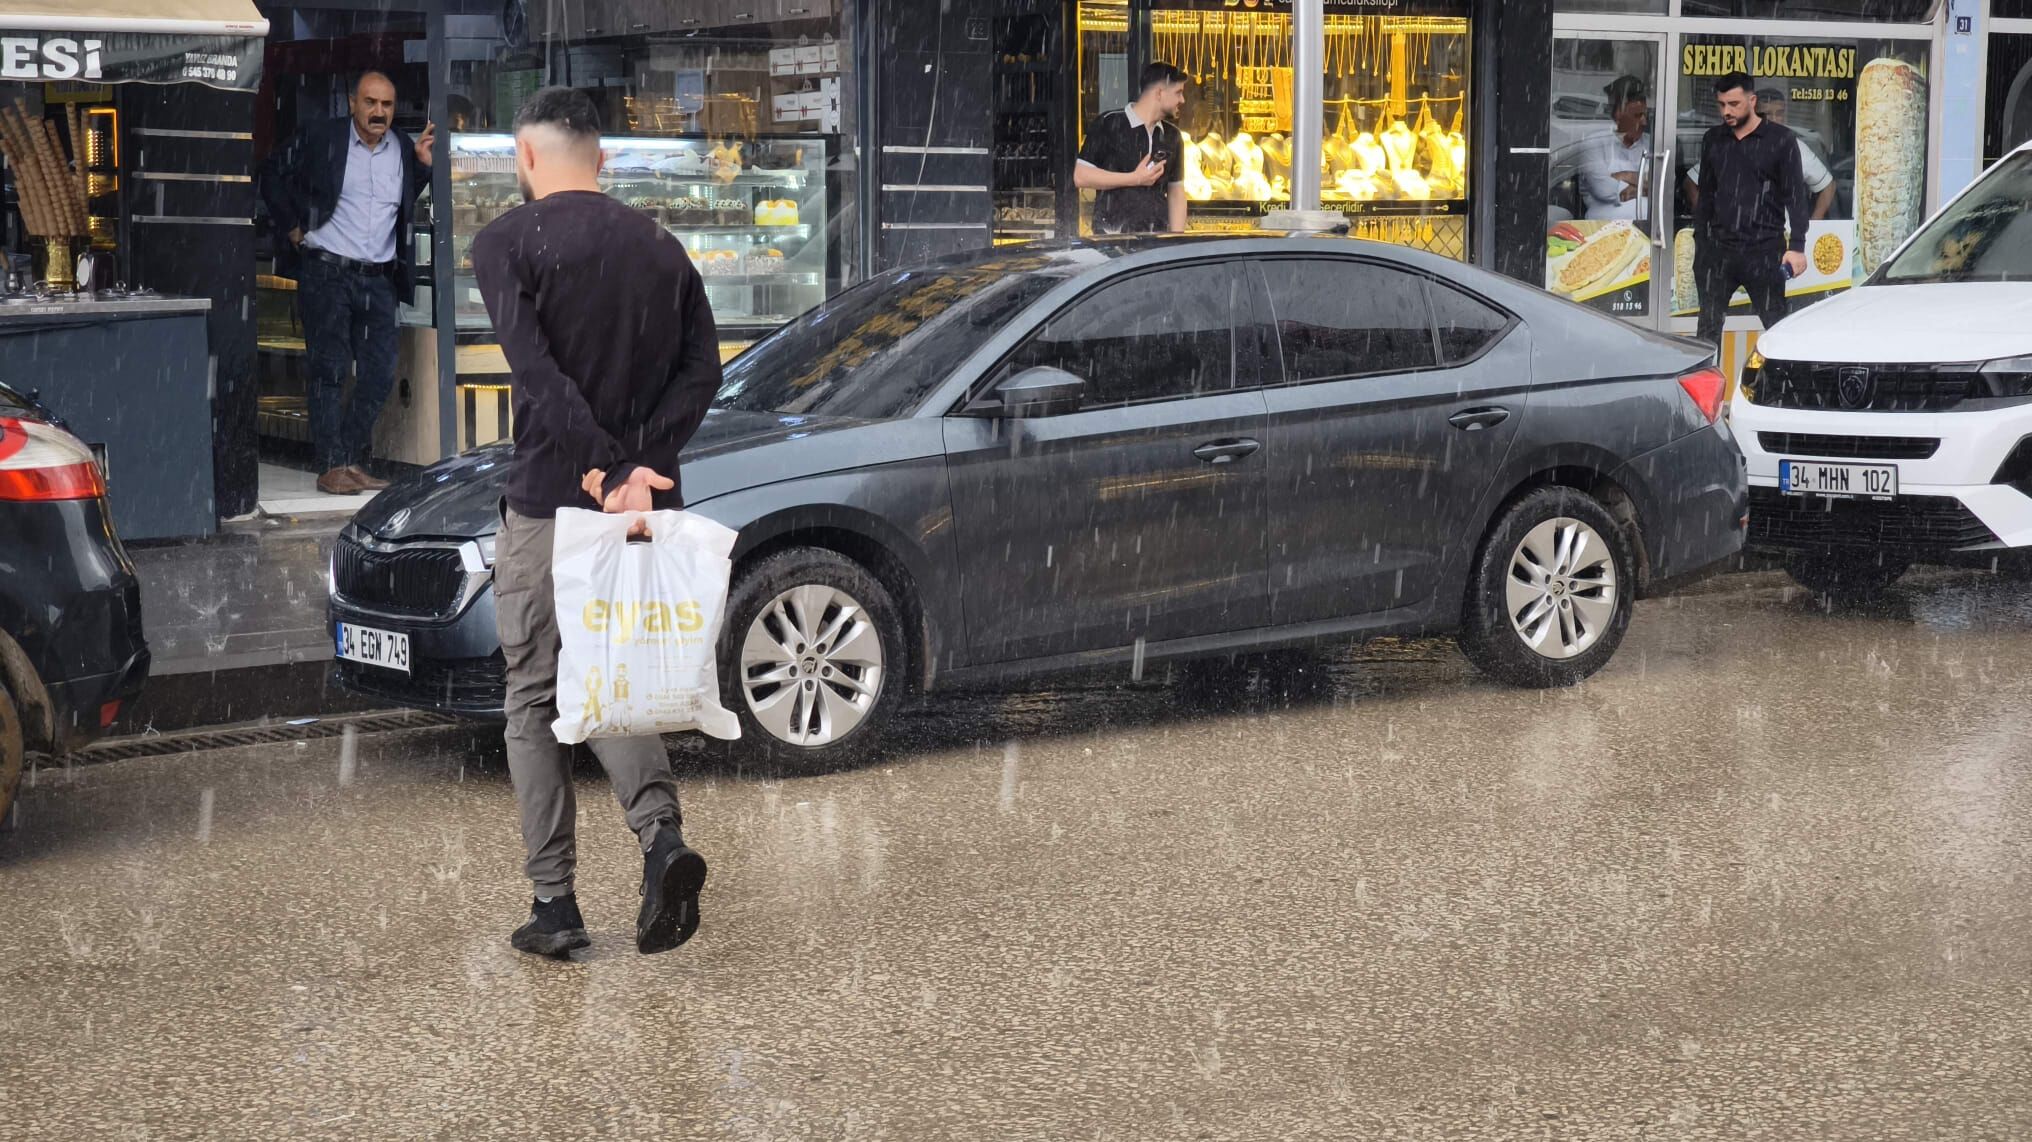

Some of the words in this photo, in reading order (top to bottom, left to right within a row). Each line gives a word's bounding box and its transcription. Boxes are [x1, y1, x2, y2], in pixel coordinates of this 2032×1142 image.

[1959, 19, 1968, 31] 31
[1683, 44, 1748, 76] SEHER
[1752, 46, 1856, 78] LOKANTASI
[1836, 88, 1849, 101] 46
[1791, 465, 1810, 489] 34
[1818, 467, 1850, 491] MHN
[1862, 469, 1890, 493] 102
[582, 598, 704, 645] eyas
[343, 626, 355, 656] 34
[360, 629, 383, 661] EGN
[387, 634, 407, 666] 749
